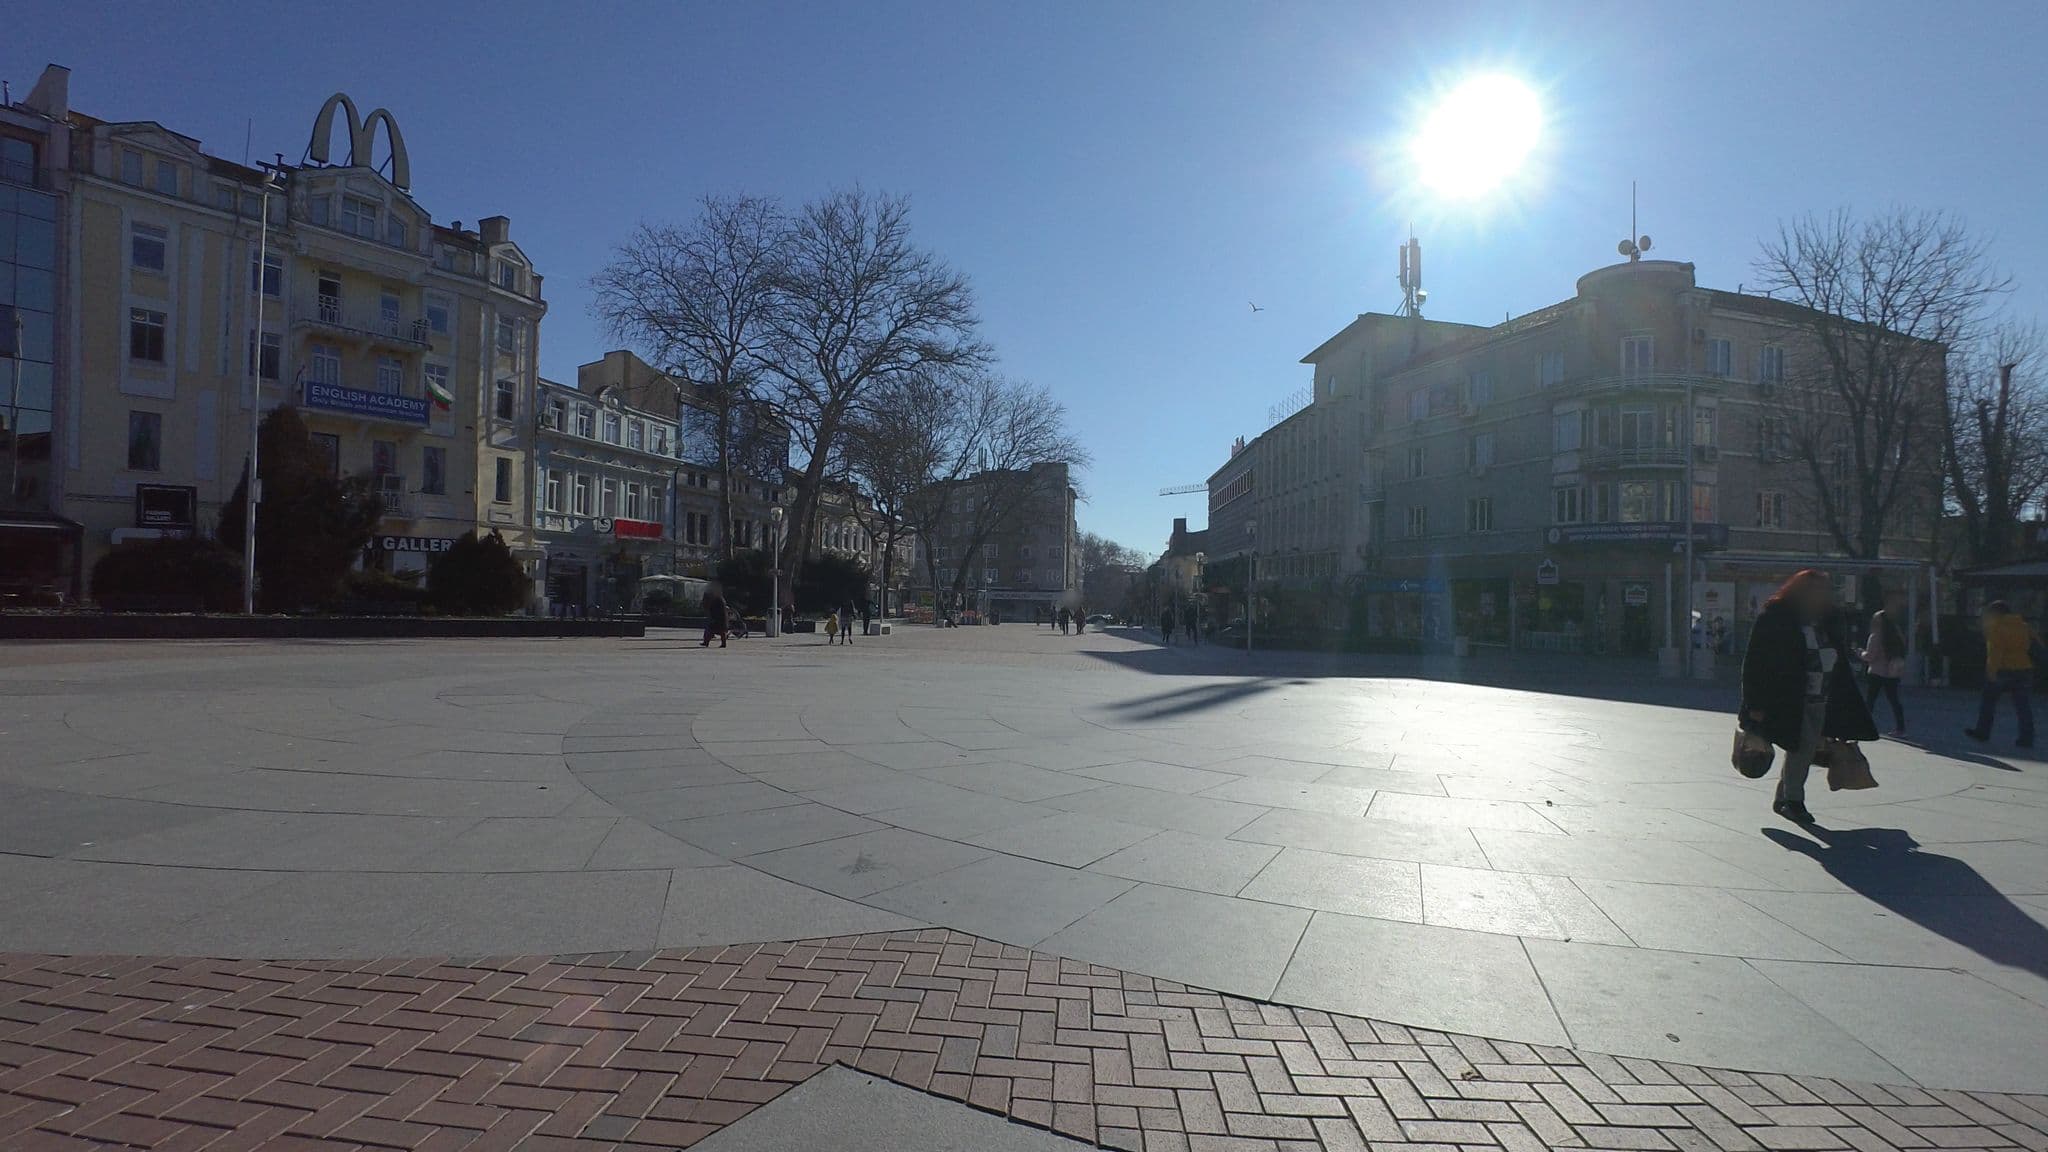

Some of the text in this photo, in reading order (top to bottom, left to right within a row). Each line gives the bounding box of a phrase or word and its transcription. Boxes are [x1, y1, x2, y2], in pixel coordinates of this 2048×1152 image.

[312, 385, 425, 411] ENGLISH ACADEMY
[382, 536, 456, 552] GALLER
